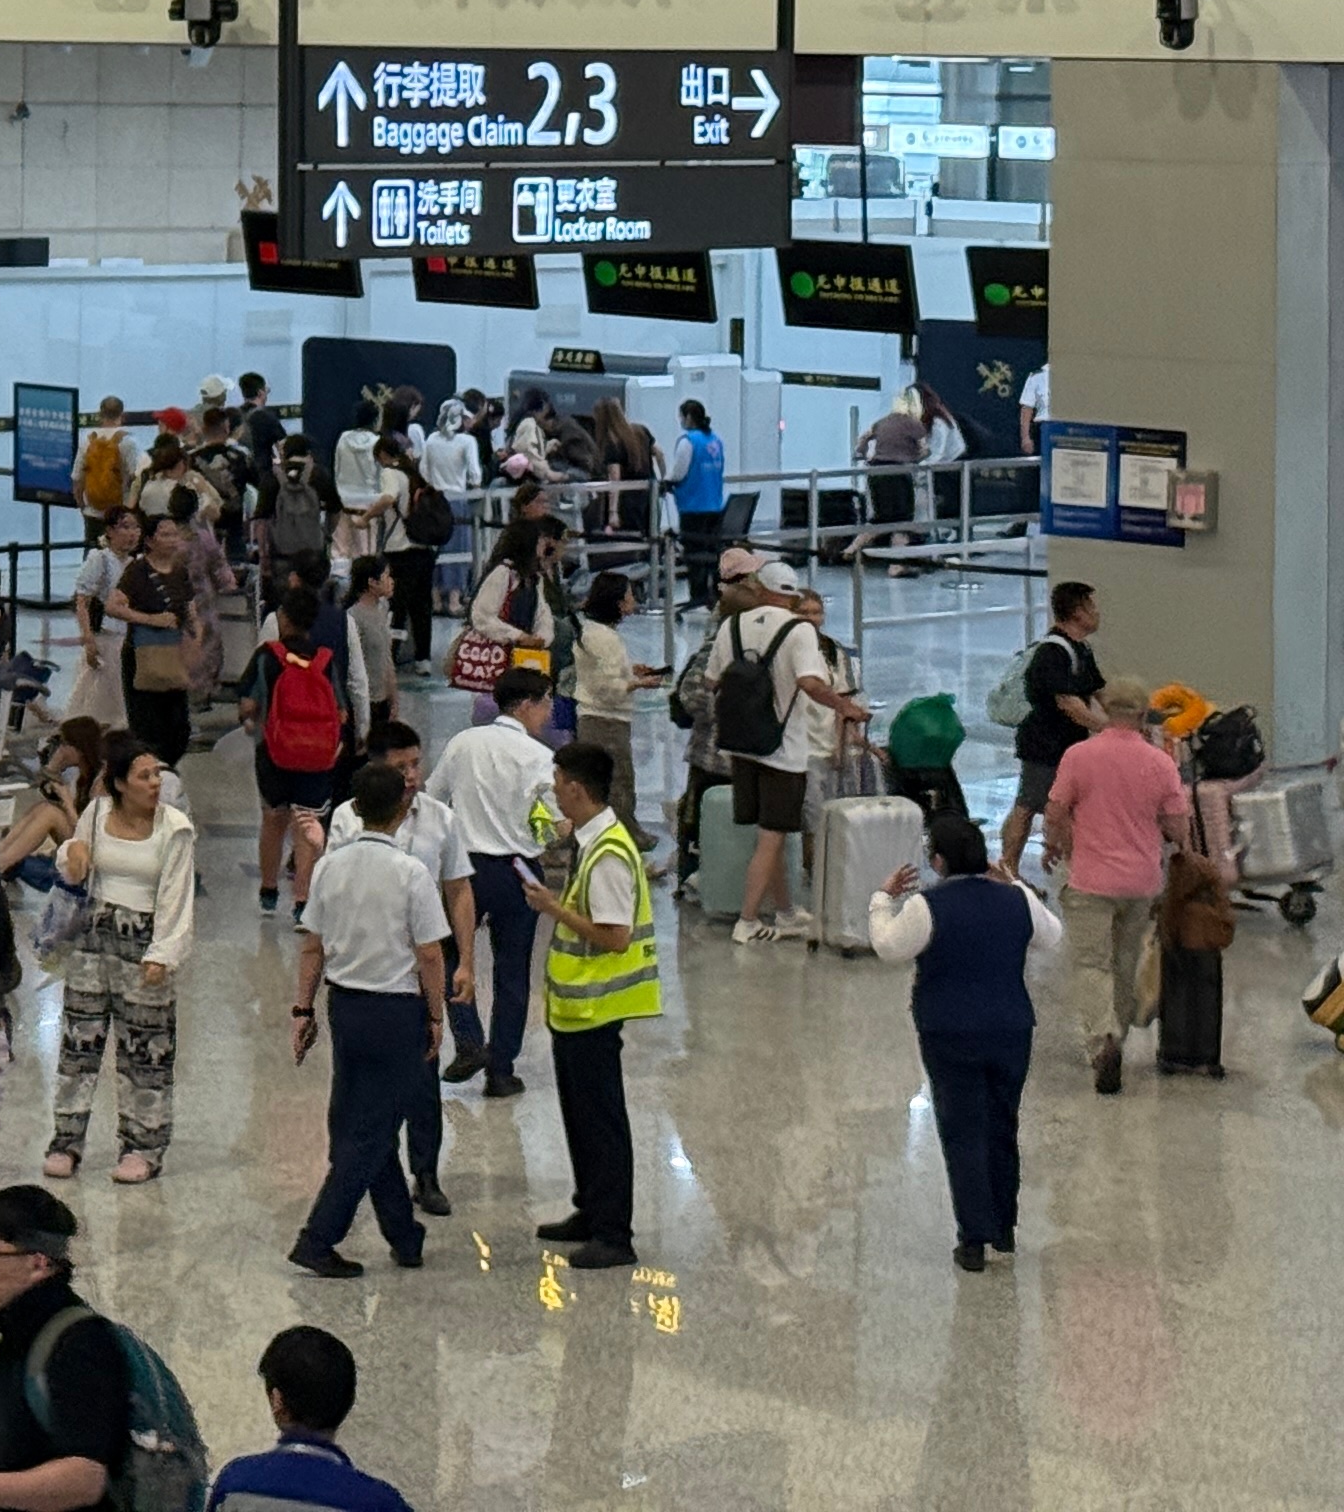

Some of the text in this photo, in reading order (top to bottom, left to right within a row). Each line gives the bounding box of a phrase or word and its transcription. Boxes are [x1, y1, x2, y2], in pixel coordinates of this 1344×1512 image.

[373, 61, 487, 108] 行李提取
[680, 63, 730, 107] 出口
[526, 61, 618, 146] 2,3
[373, 114, 524, 154] Baggage Claim
[693, 113, 730, 144] Exit
[417, 179, 482, 216] 洗手间
[555, 176, 617, 212] 更衣室
[417, 219, 471, 245] Toilets
[554, 217, 652, 242] Locker Room
[458, 642, 505, 664] GOOD
